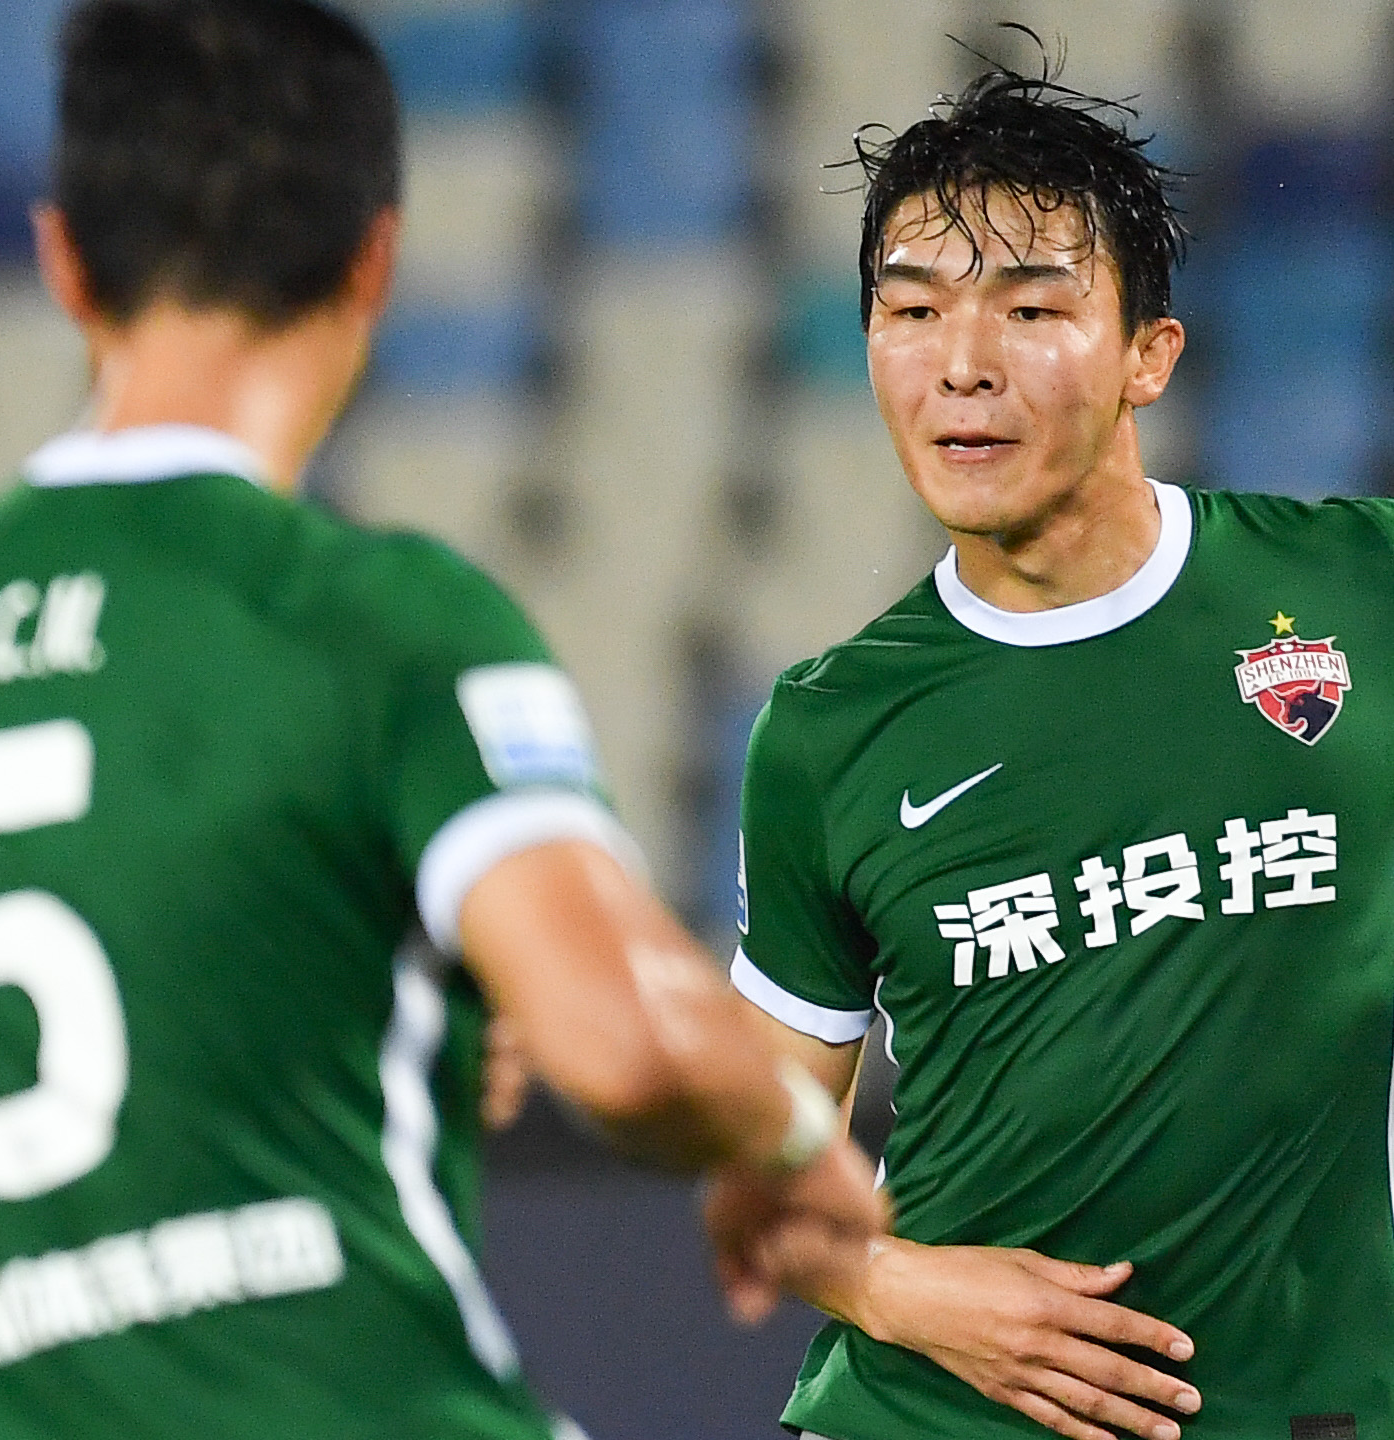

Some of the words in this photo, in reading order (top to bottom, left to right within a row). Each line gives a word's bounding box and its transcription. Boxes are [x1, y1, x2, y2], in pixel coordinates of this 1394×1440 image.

[1243, 654, 1341, 683] SHENZHEN
[933, 808, 1337, 987] 深投控
